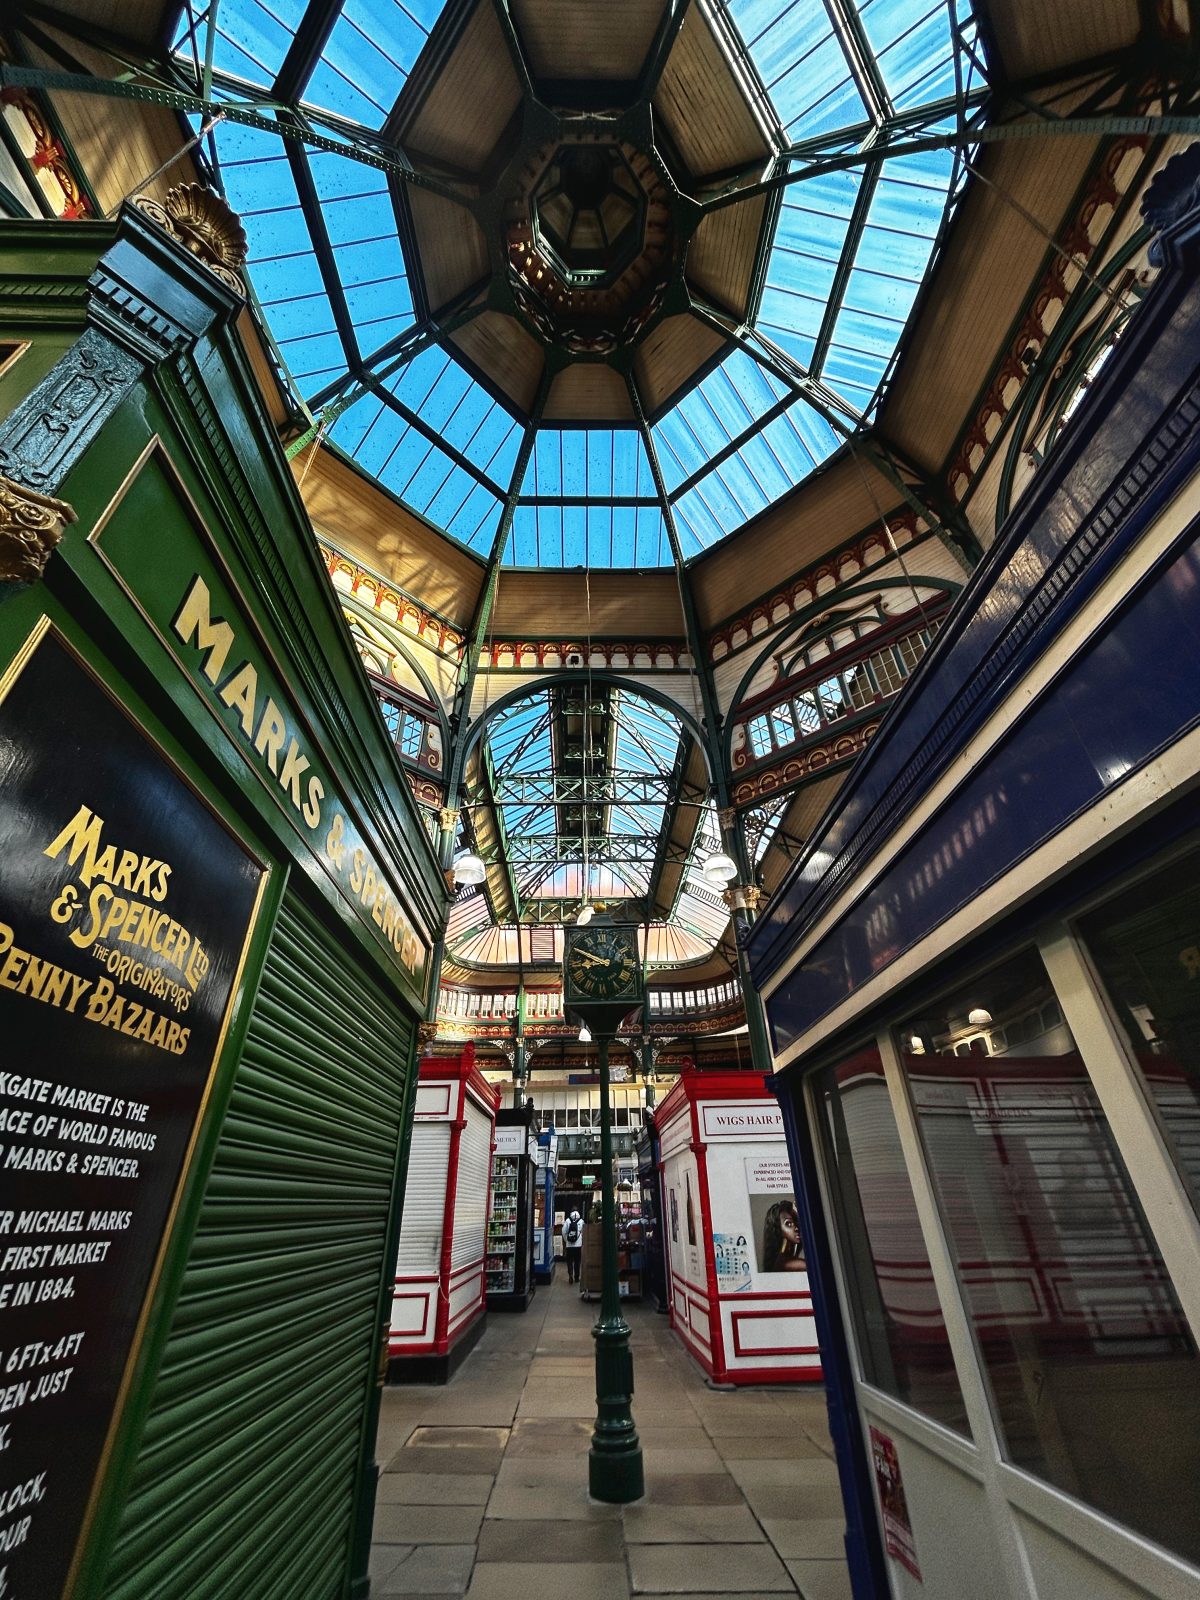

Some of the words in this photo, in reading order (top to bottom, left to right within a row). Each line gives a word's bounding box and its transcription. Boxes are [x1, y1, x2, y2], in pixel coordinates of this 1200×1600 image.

[173, 574, 326, 829] MARKS
[326, 813, 346, 871] &
[350, 848, 417, 977] SPENCER
[43, 804, 172, 902] MARKS
[51, 884, 83, 924] &
[69, 883, 191, 969] SPENCER
[92, 943, 110, 963] THE
[106, 949, 192, 1013] ORIGINATORS
[85, 976, 191, 1055] BAZAARS
[51, 1084, 112, 1114] MARKET
[110, 1098, 125, 1117] IS
[125, 1101, 150, 1122] THE
[717, 1116, 744, 1125] WIGS
[747, 1115, 773, 1125] HAIR
[33, 1115, 59, 1137] OF
[58, 1118, 108, 1145] WORLD
[108, 1127, 157, 1151] FAMOUS
[3, 1145, 66, 1172] MARKS
[66, 1152, 78, 1173] &
[81, 1154, 139, 1178] SPENCER.
[14, 1210, 85, 1234] MICHAEL
[86, 1210, 133, 1231] MARKS
[0, 1245, 53, 1271] FIRST
[50, 1241, 111, 1267] MARKET
[10, 1281, 36, 1307] IN
[30, 1366, 74, 1402] JUST
